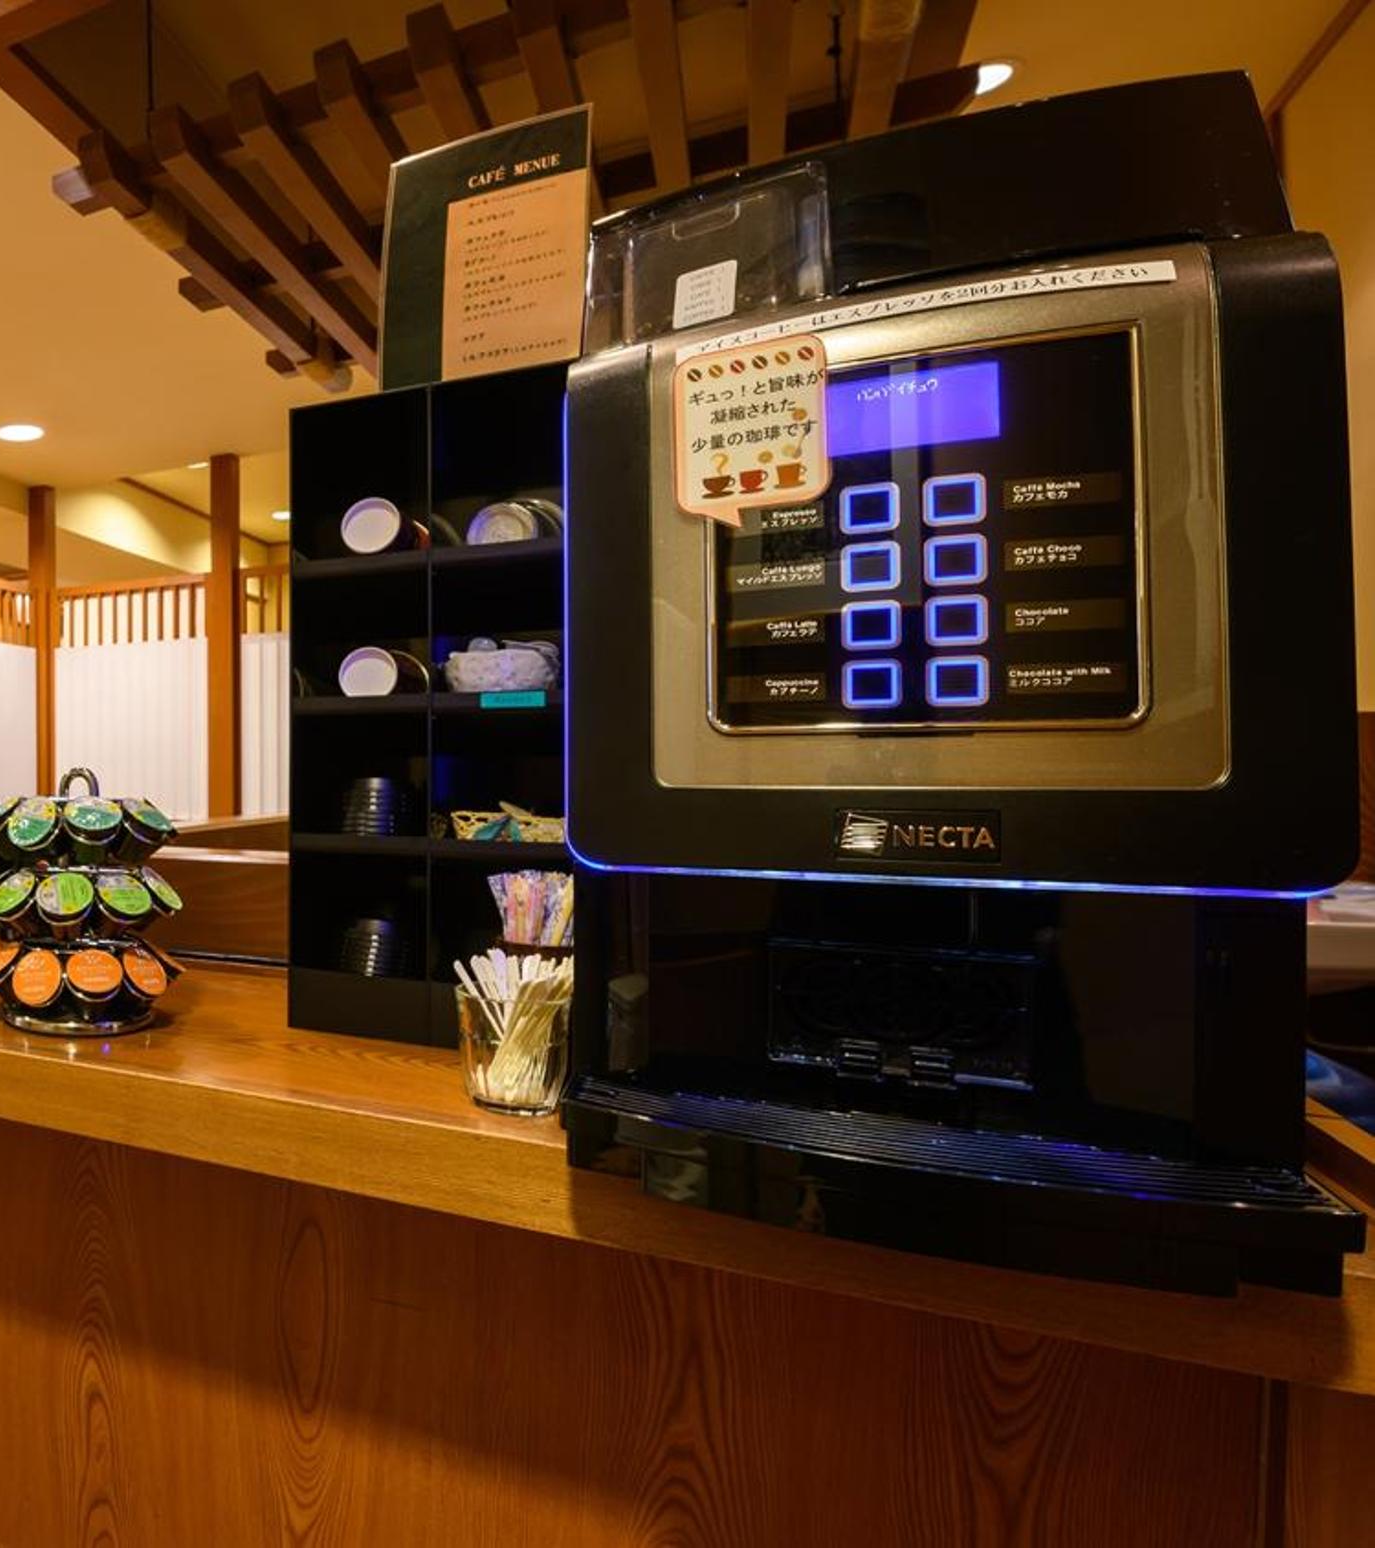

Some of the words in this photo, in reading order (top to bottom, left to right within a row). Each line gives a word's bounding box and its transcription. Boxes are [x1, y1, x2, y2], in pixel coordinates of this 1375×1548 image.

[468, 164, 505, 189] CAFÉ
[513, 153, 561, 177] MENUE
[710, 399, 797, 425] 凝縮された
[691, 419, 818, 453] 少量の珈琲です
[1046, 480, 1081, 490] Mocha
[1012, 490, 1068, 503] カフェモカ
[761, 516, 818, 528] エスプレッソ
[1047, 543, 1082, 553] Choco
[1014, 553, 1077, 566] カフェチョコ
[736, 572, 823, 585] マイルドエスプレッソ
[1015, 607, 1070, 617] Chocolate
[1015, 616, 1046, 627] ココア
[771, 628, 818, 639] カフェラテ
[1009, 668, 1063, 678] Chocolate
[1065, 666, 1088, 676] with
[1091, 665, 1112, 676] Milk
[1009, 676, 1073, 688] ミルクココア
[770, 687, 818, 697] カプチーノ
[892, 824, 996, 849] NECTA
